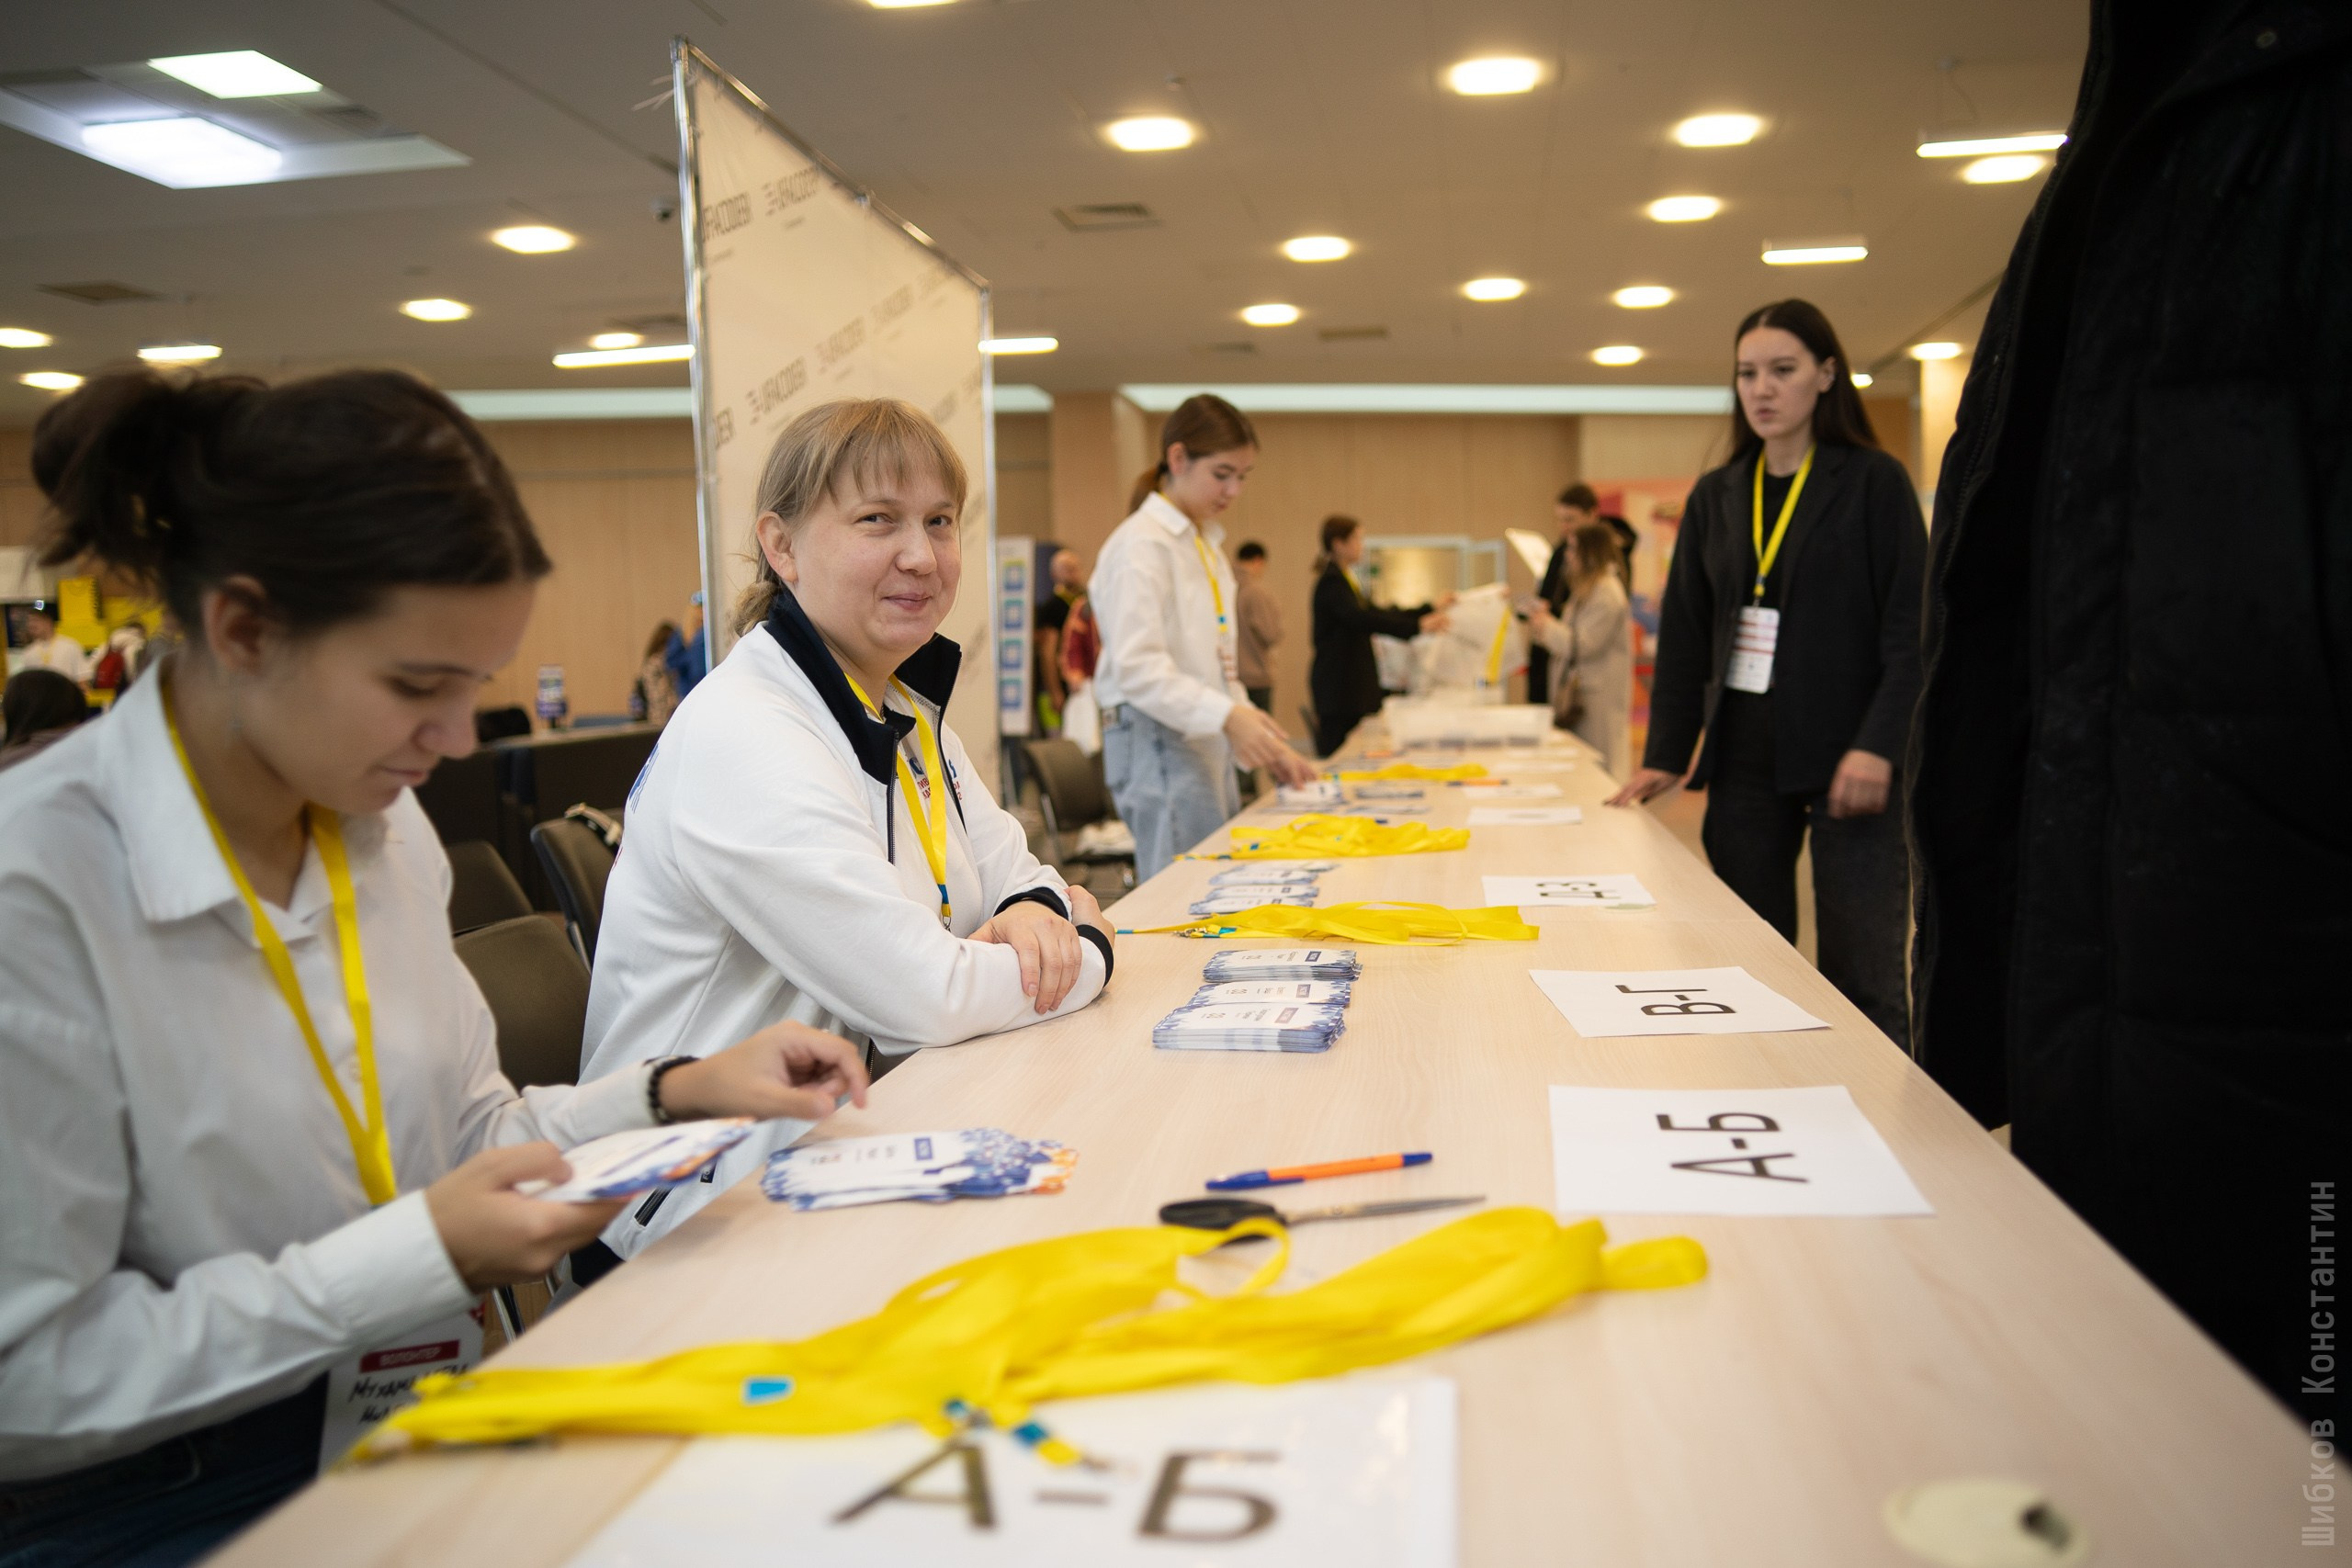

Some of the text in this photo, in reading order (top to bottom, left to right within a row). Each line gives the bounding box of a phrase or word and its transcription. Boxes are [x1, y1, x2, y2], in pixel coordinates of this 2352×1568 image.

[1614, 983, 1736, 1017] В-Г
[1656, 1111, 1811, 1184] А-Б
[830, 1438, 1283, 1545] А-Б
